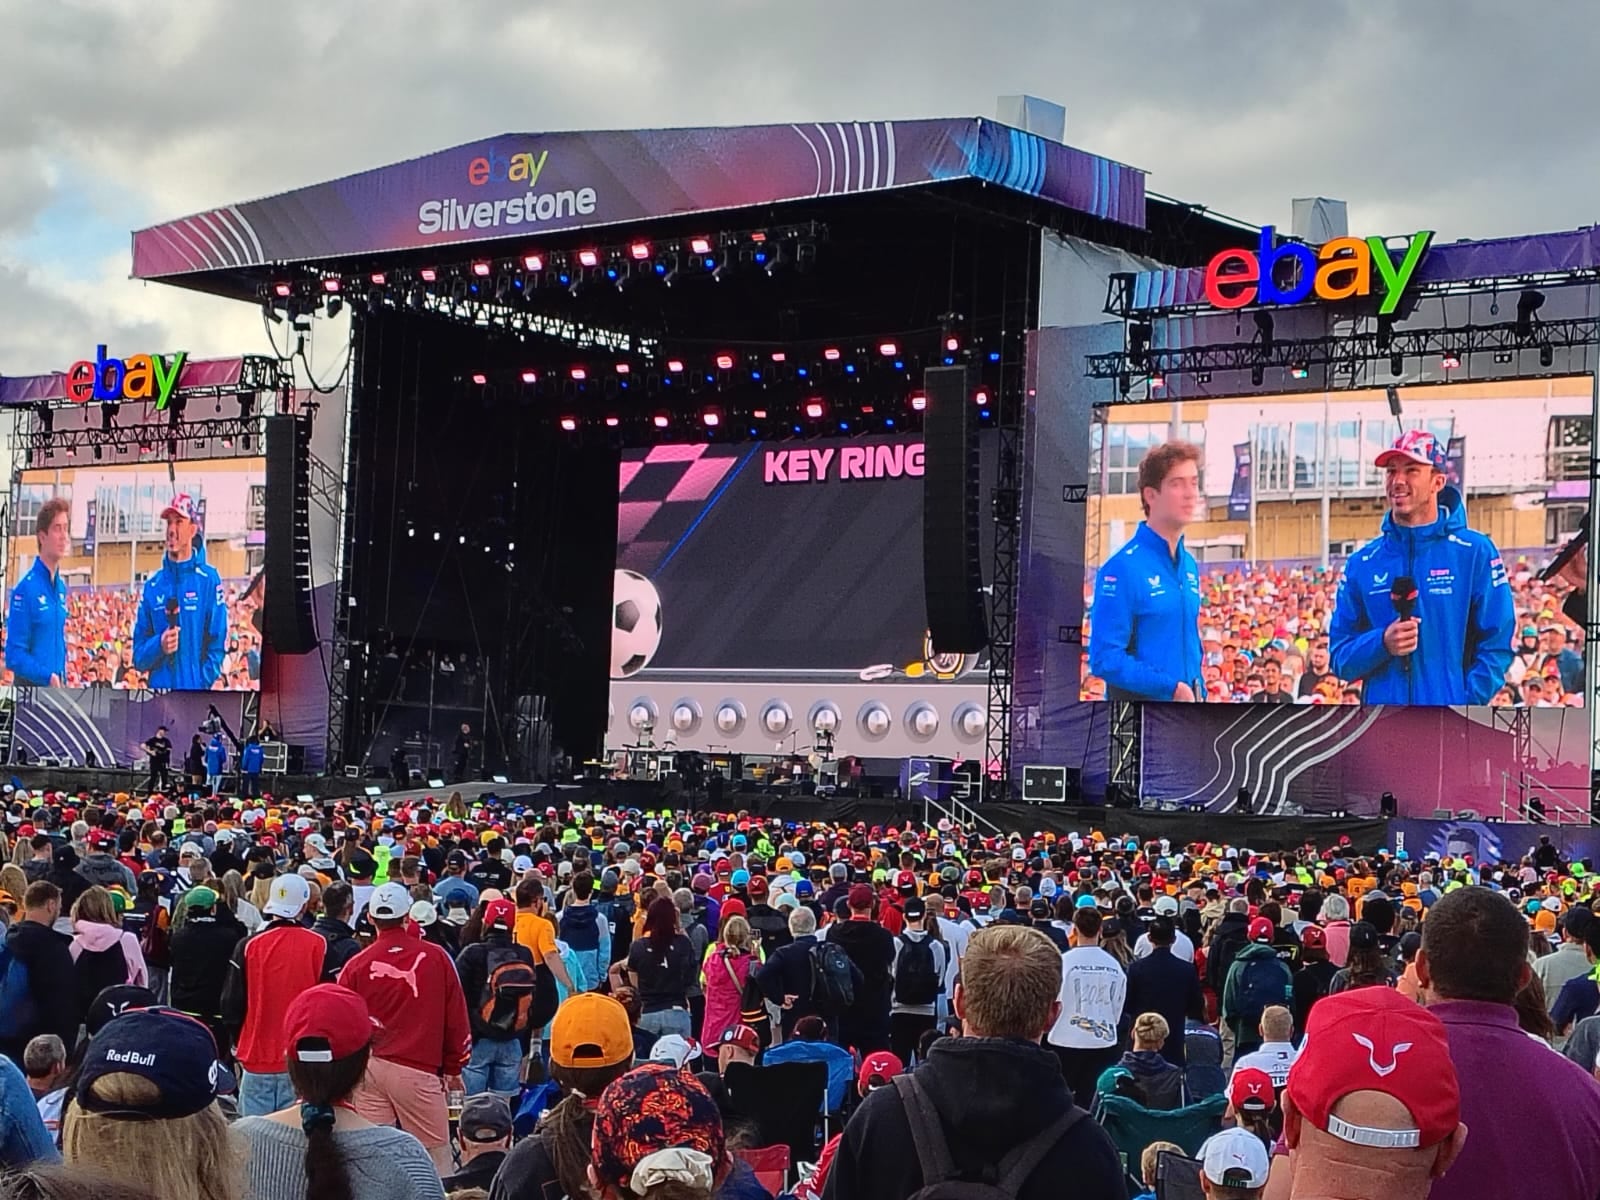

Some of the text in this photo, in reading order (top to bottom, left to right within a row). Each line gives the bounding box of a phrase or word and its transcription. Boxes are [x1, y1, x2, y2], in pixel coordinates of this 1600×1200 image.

[468, 147, 549, 187] ebay
[418, 187, 597, 235] Silverstone
[1205, 224, 1434, 315] ebay
[66, 344, 187, 410] ebay
[764, 443, 925, 483] KEY RING
